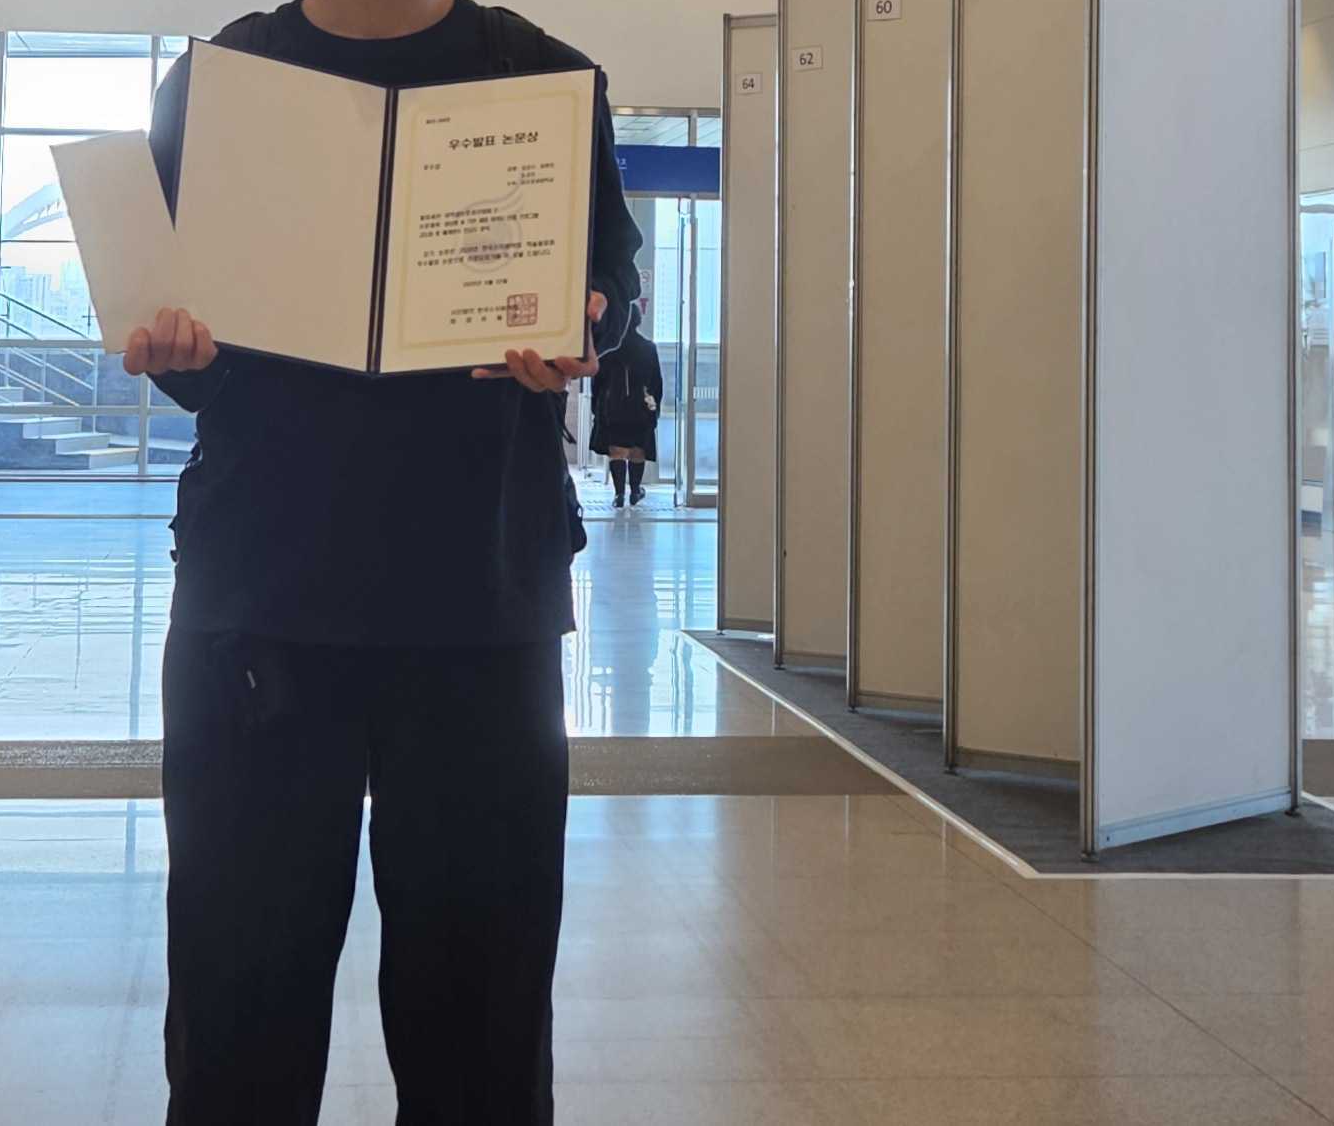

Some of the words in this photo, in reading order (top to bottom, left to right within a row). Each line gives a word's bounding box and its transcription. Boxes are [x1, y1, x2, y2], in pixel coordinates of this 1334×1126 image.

[875, 0, 893, 14] 60
[799, 53, 814, 65] 62
[742, 78, 755, 90] 64
[448, 134, 495, 150] 우수발표
[502, 131, 539, 146] 논문상
